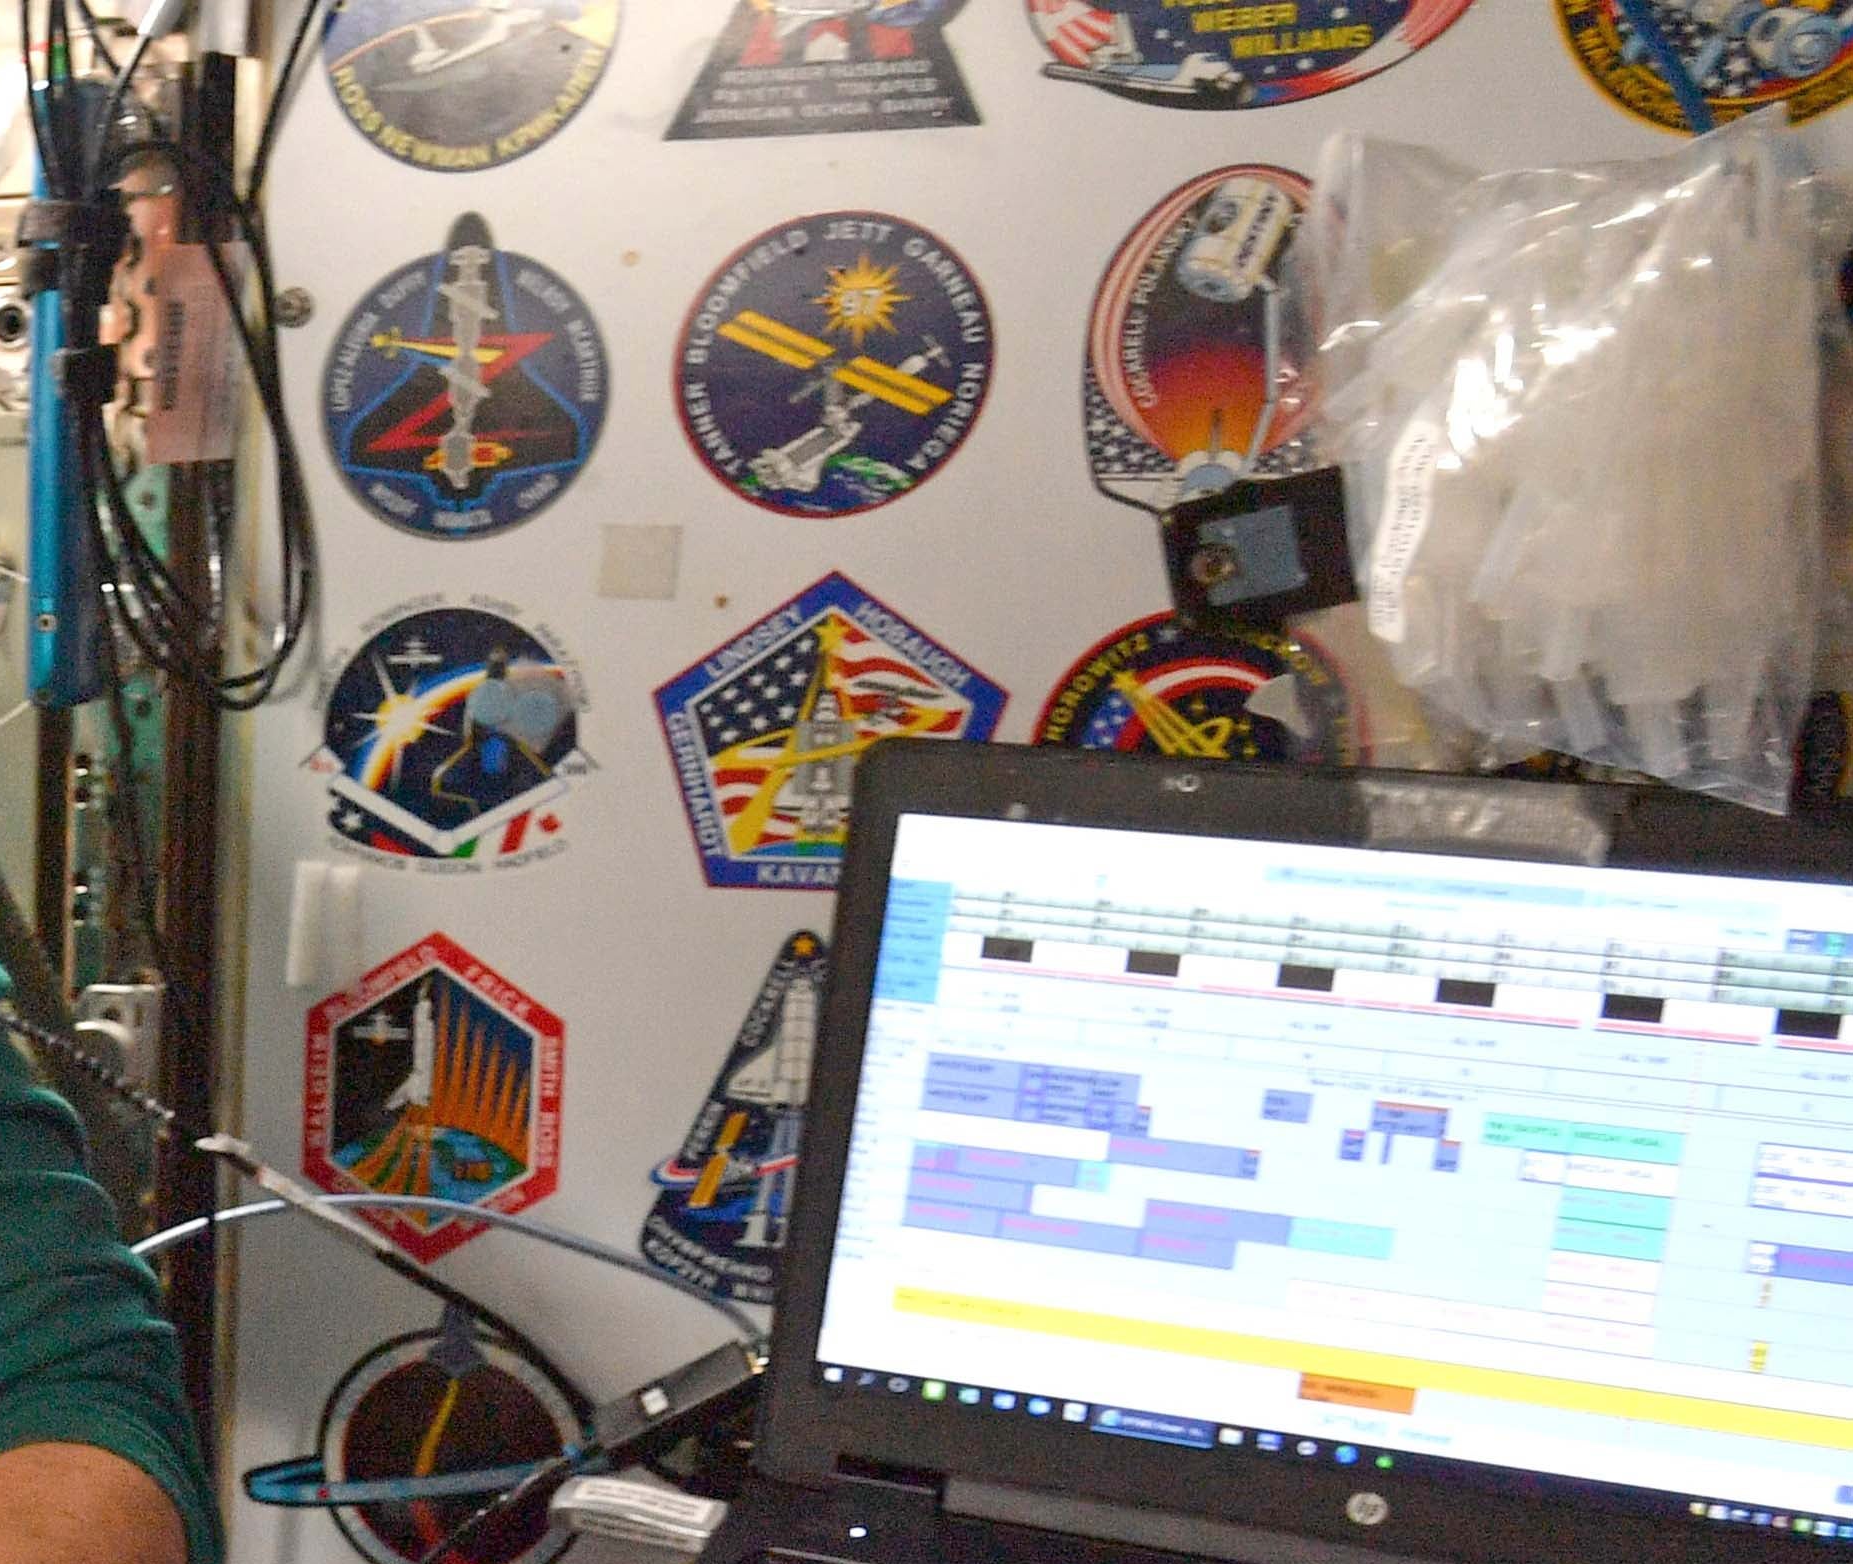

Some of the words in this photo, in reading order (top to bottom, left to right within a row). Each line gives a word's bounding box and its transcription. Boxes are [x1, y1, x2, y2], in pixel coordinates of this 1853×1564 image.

[1193, 4, 1298, 33] WEBER
[1230, 24, 1374, 59] WILLIAMS
[822, 219, 894, 242] JETT
[686, 228, 810, 366] BLOOMFIELD
[840, 288, 884, 317] 97
[902, 236, 986, 344] GARNEAU
[684, 381, 743, 477] TANNER
[906, 361, 986, 470] NORIEGA
[702, 607, 805, 680] LINDSEY
[852, 600, 974, 690] HOBAUGH
[1045, 633, 1148, 742] HOROWITZ
[757, 863, 842, 884] KAVAN
[463, 964, 533, 1017] FRICK
